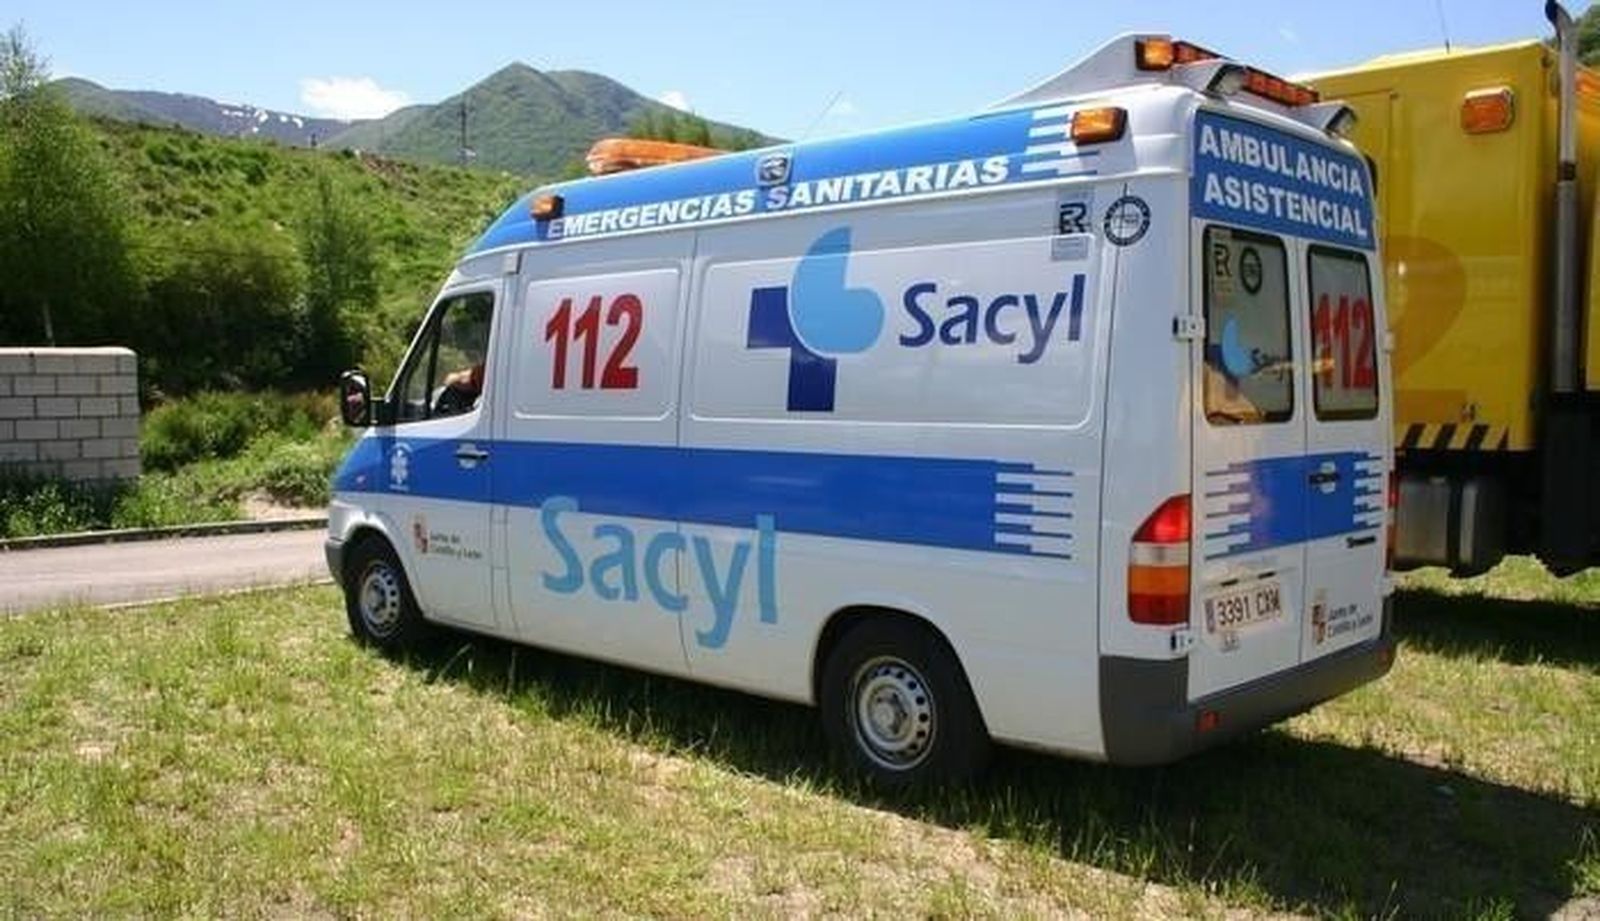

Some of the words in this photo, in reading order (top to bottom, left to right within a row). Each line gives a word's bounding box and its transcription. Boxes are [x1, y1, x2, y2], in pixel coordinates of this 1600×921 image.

[547, 190, 755, 239] EMERGENCIAS
[767, 156, 1010, 209] SANITARIAS
[1200, 125, 1364, 197] AMBULANCIA
[1203, 173, 1367, 237] ASISTENCIAL
[545, 294, 642, 389] 112
[899, 274, 1086, 364] Sacyl
[1316, 293, 1375, 389] 112
[542, 496, 777, 649] Sacyl
[1217, 596, 1250, 627] 3391
